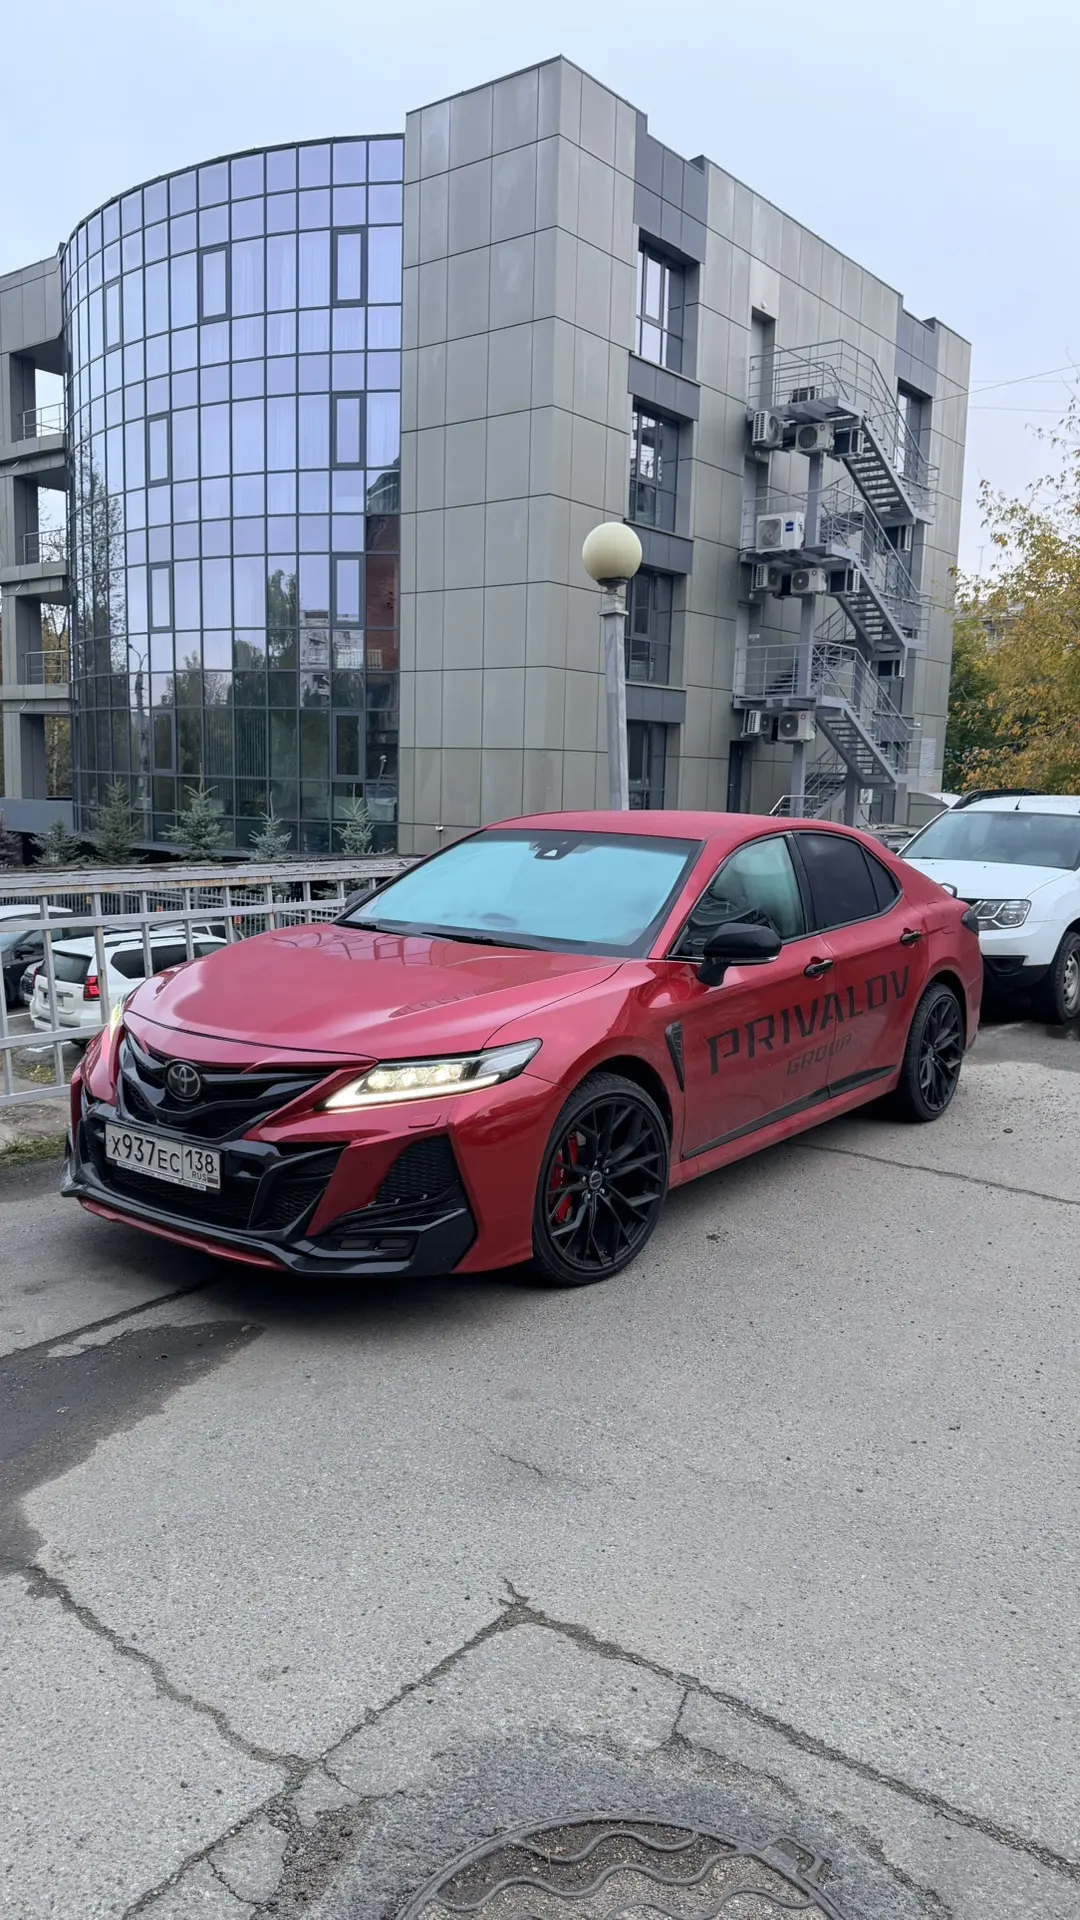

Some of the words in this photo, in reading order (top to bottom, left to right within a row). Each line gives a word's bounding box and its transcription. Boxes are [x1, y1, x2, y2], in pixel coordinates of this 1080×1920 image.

[706, 965, 910, 1076] PRIVALOV
[786, 1033, 852, 1076] GROUP
[185, 1149, 214, 1174] 138
[191, 1170, 207, 1182] RUS
